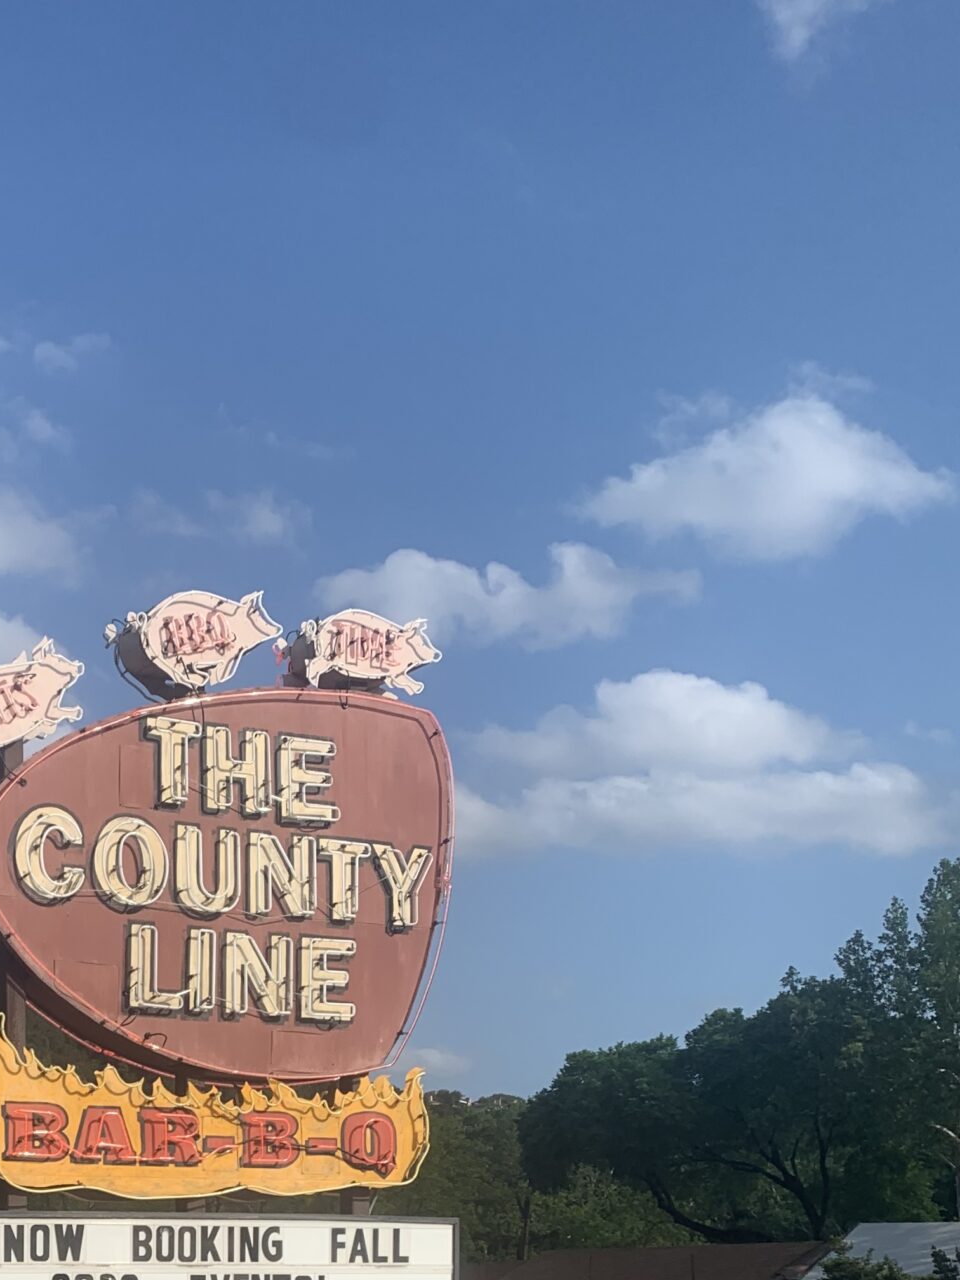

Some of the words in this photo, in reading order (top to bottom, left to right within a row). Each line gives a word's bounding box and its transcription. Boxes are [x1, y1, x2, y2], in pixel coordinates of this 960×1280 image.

[146, 716, 342, 826] THE
[14, 806, 434, 928] COUNTY
[128, 922, 357, 1021] LINE
[2, 1102, 397, 1178] BAR-B-Q
[3, 1224, 85, 1263] NOW
[132, 1225, 283, 1263] BOOKING
[330, 1227, 410, 1263] FALL
